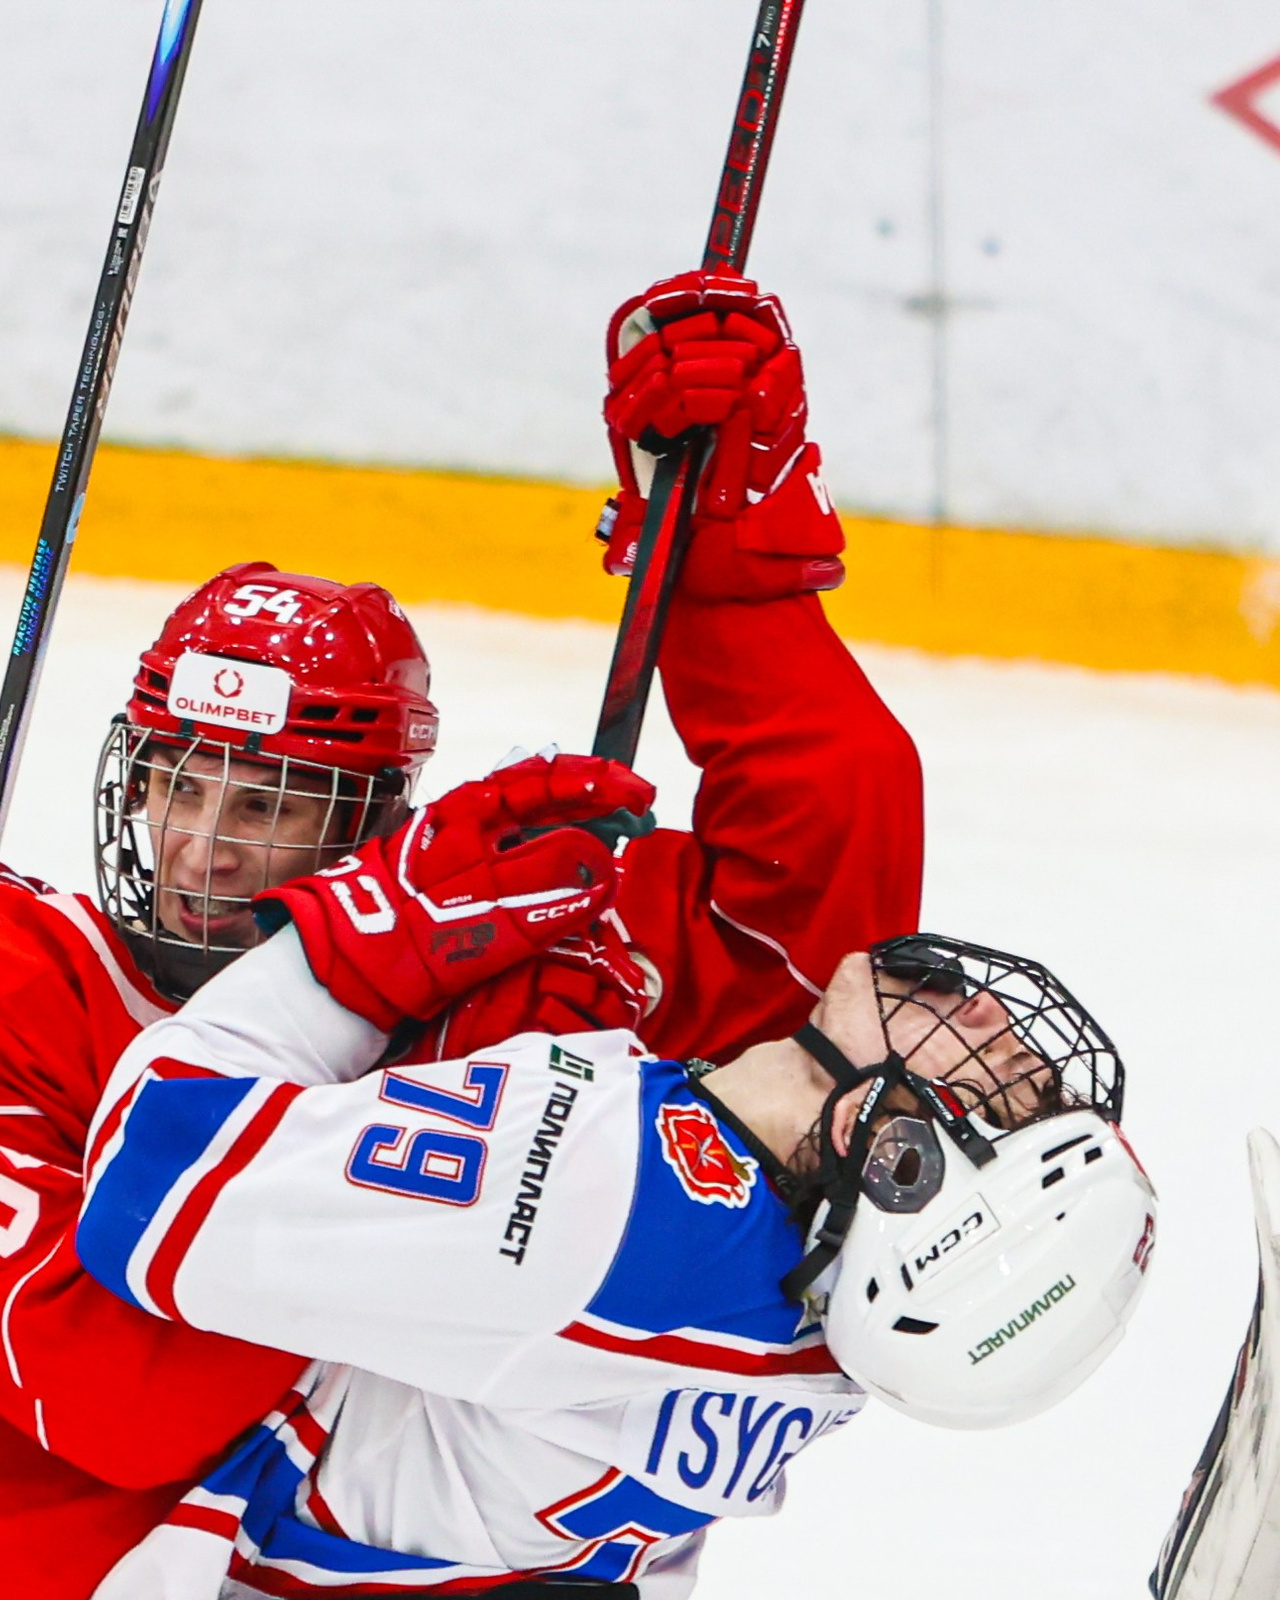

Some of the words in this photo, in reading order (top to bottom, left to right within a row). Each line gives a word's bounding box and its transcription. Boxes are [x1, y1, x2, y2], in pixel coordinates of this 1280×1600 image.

[54, 442, 73, 494] TWITCH
[69, 395, 86, 439] TAPER
[80, 301, 107, 390] TECHNOLOGY
[13, 595, 34, 657] REACTIVE
[28, 537, 49, 592] RELEASE
[223, 584, 304, 624] 54
[175, 696, 277, 727] OLIMPBET
[526, 896, 592, 924] CCM
[345, 1062, 510, 1207] 79
[858, 1075, 887, 1123] CCM
[499, 1082, 578, 1266] ПОЛИПЛАСТ
[915, 1211, 984, 1276] CCM
[967, 1274, 1076, 1365] ПОЛИПЛАСТ
